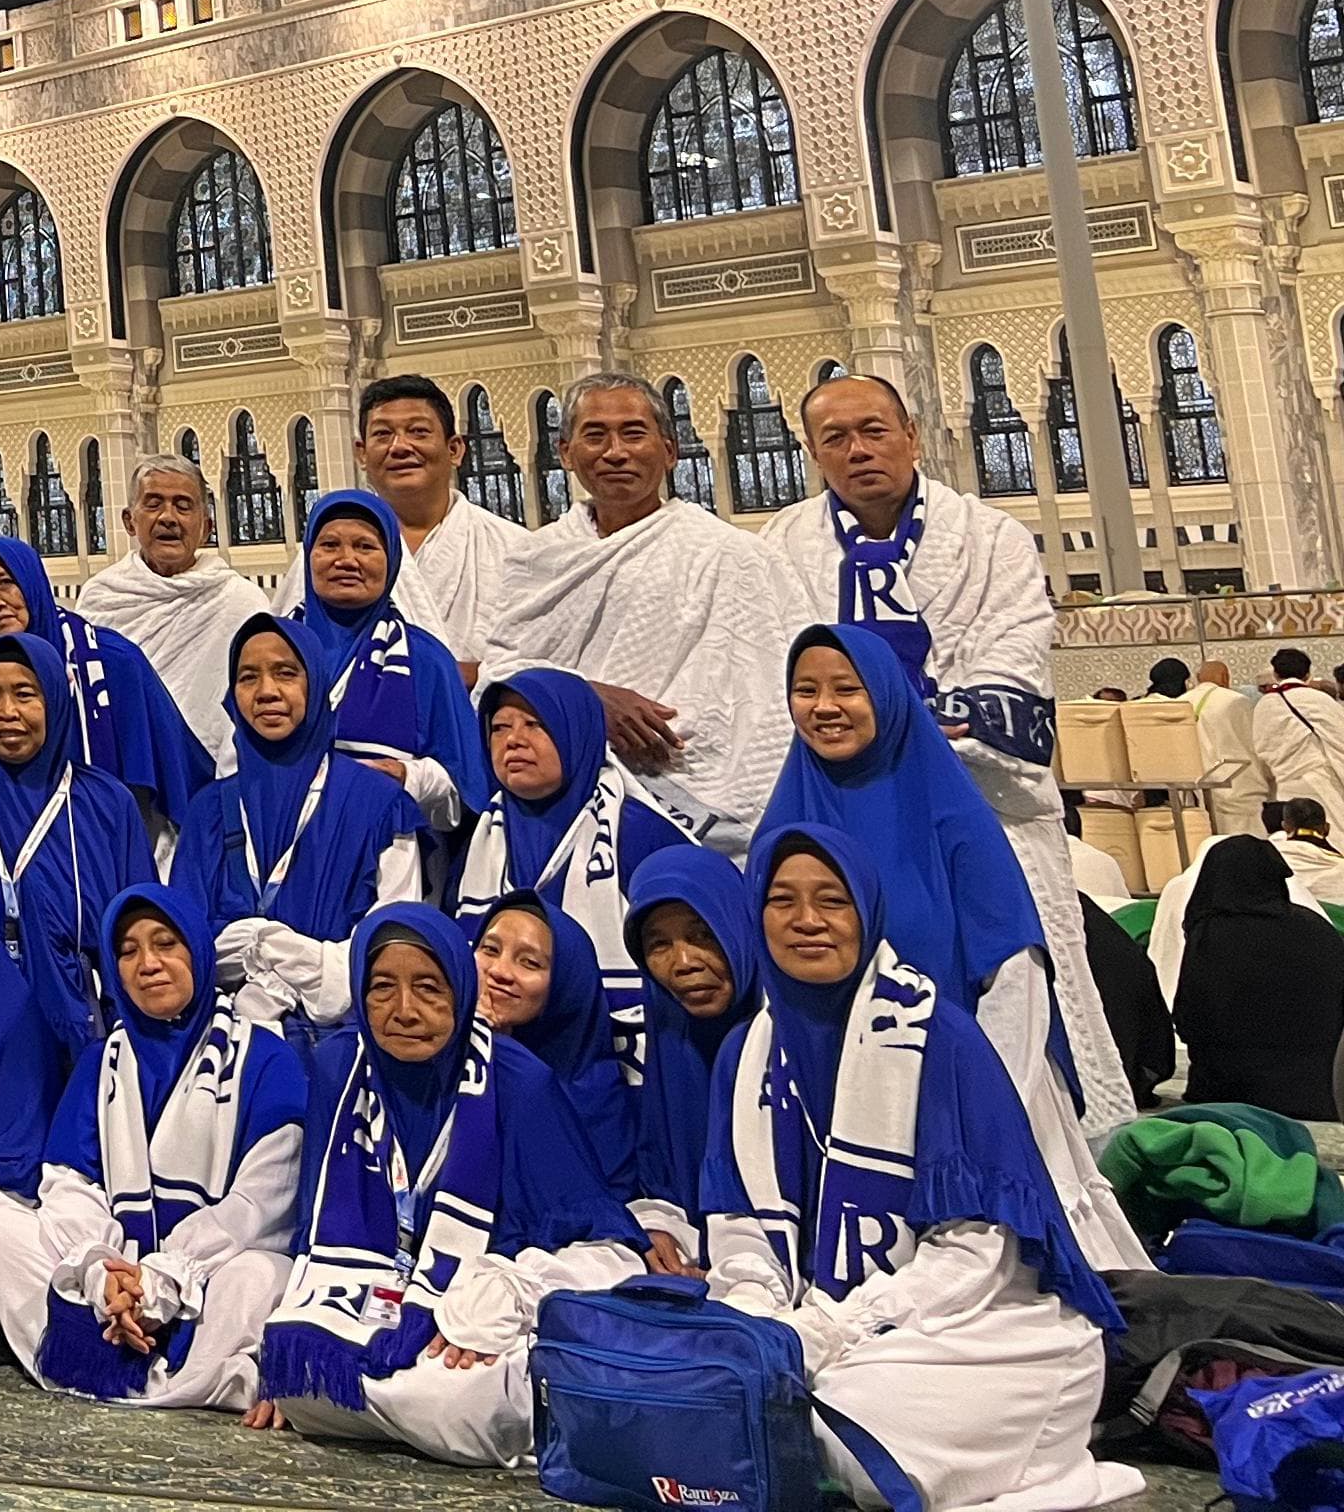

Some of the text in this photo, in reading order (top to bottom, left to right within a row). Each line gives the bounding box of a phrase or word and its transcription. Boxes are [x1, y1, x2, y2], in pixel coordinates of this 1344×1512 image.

[854, 562, 918, 622] R
[834, 1202, 902, 1282] R
[651, 1476, 681, 1504] R
